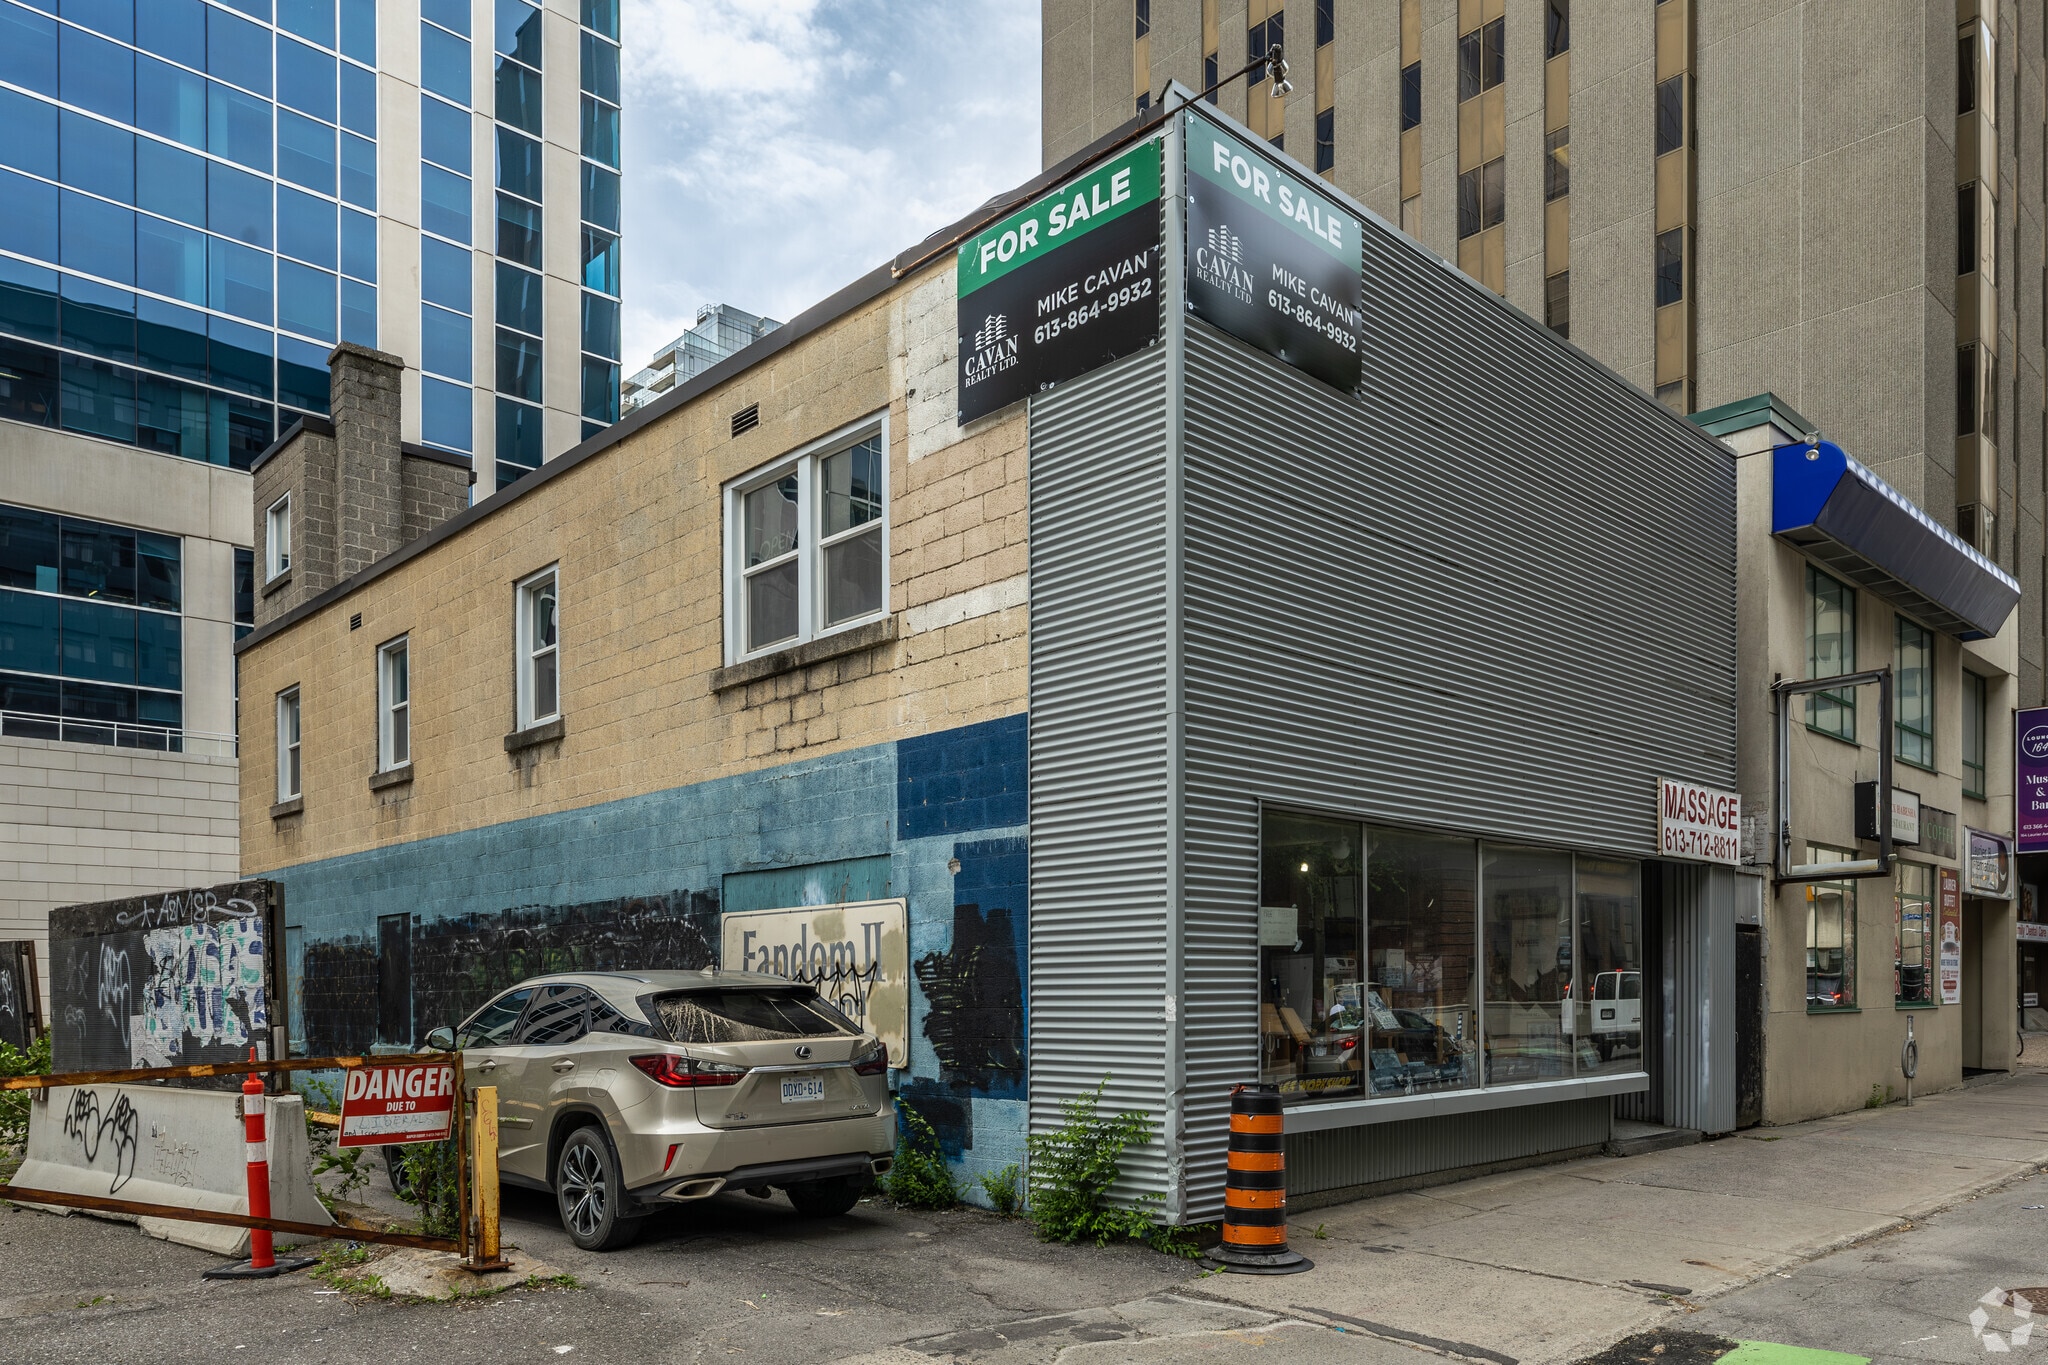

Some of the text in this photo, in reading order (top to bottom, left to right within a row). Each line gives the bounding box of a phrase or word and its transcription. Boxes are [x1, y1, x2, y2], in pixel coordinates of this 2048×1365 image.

[1213, 140, 1342, 250] FOR SALE
[980, 167, 1130, 274] FOR SALE
[1038, 251, 1148, 317] MIKE CAVAN
[1196, 247, 1254, 294] CAVAN
[1196, 267, 1254, 306] REALTY LTD.
[1034, 277, 1152, 345] 613-864-9932
[1272, 263, 1354, 326] MIKE CAVAN
[1268, 289, 1357, 353] 613-864-9932
[965, 335, 1019, 376] CAVAN
[965, 355, 1019, 388] REALTY LTD.
[1664, 783, 1738, 830] MASSAGE
[2036, 787, 2046, 797] &
[1665, 826, 1737, 861] 613-712-8811
[1927, 822, 1956, 844] COFFEE
[743, 923, 856, 983] Fandom
[346, 1067, 455, 1101] DANGER
[1298, 1075, 1352, 1092] WORKSHOP
[358, 1113, 434, 1130] LIBERALS
[386, 1100, 416, 1112] DUE TO
